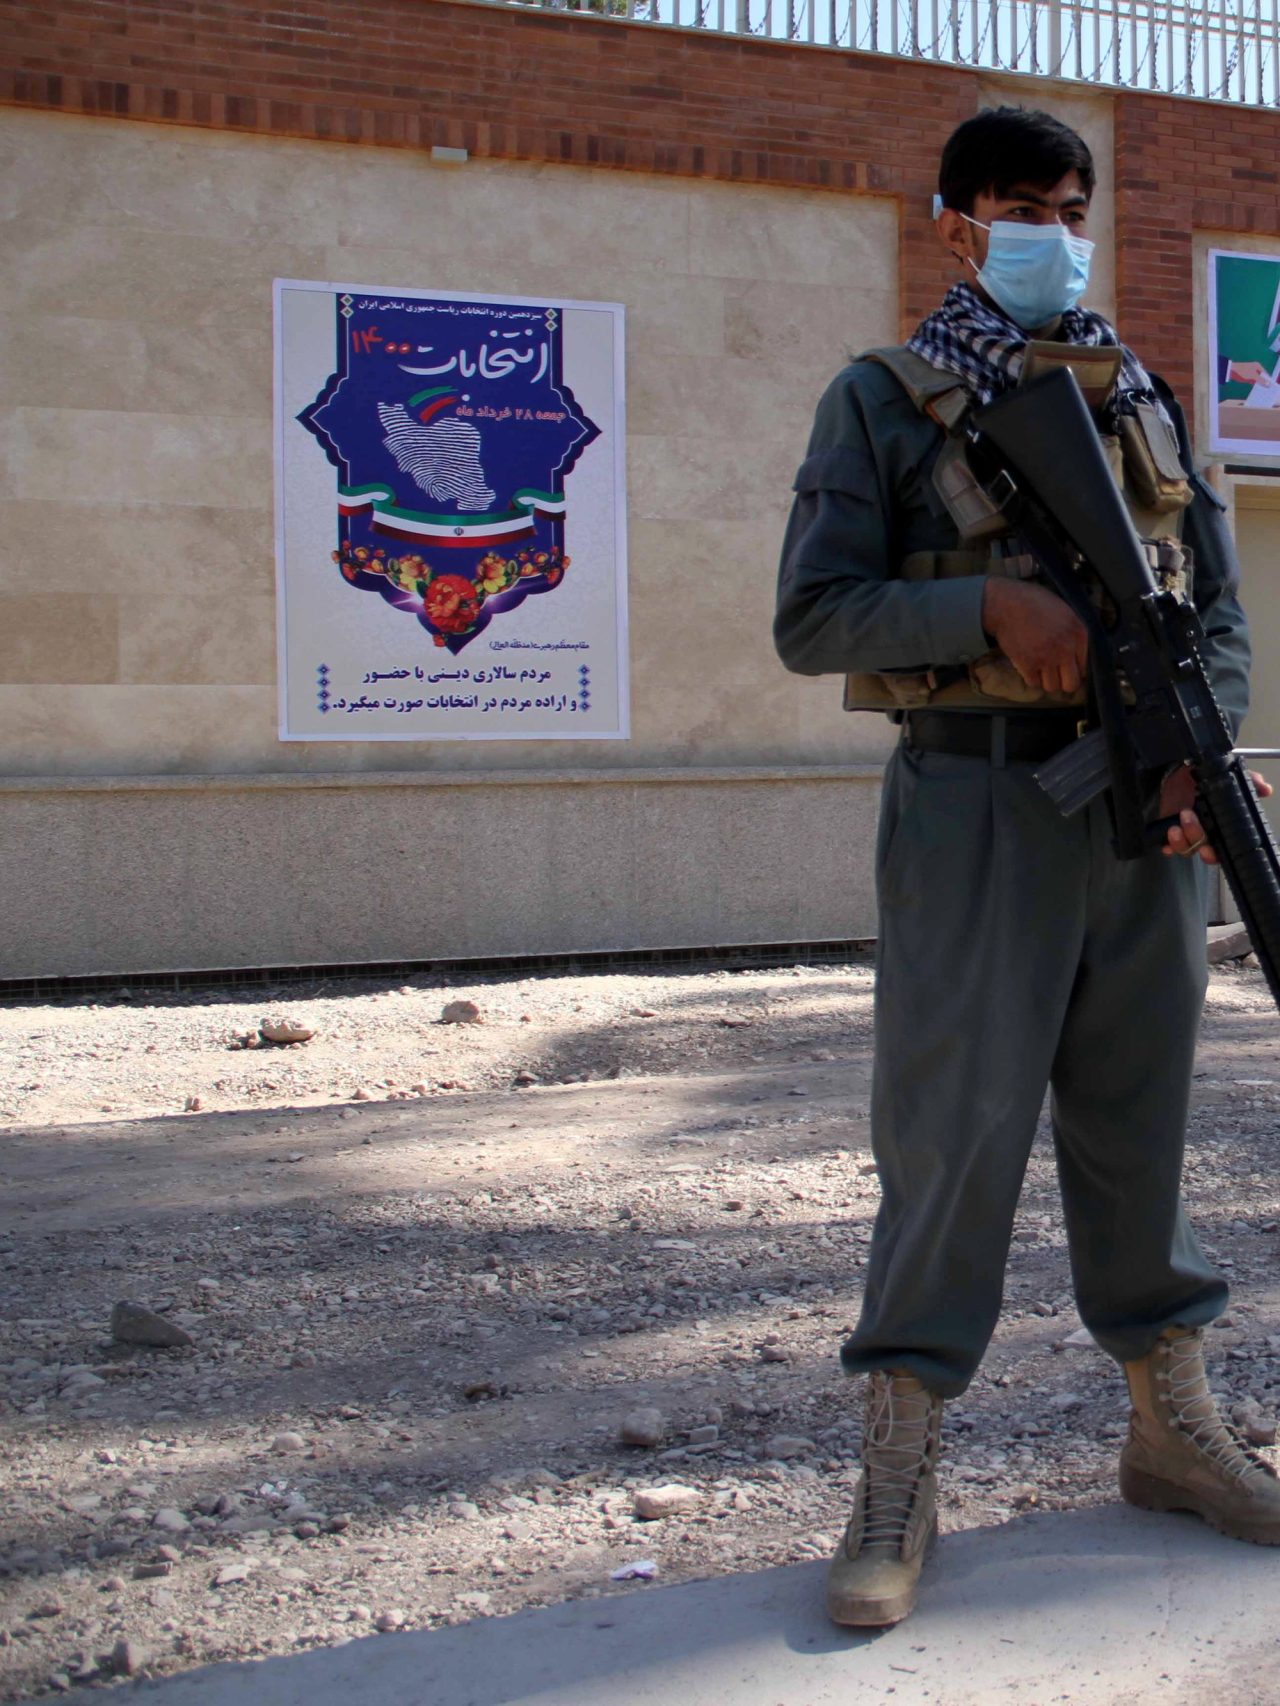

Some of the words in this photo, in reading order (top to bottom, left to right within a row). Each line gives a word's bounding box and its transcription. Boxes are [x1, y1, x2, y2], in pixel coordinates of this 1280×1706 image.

[358, 300, 379, 310] ایران
[379, 302, 405, 311] اسلامی
[405, 304, 435, 314] جمهوری
[436, 304, 460, 316] ریاست
[460, 307, 489, 317] انتخابات
[490, 310, 507, 319] دوره
[508, 311, 542, 321] سیزدهمین
[397, 328, 548, 402] انتخابات
[456, 404, 474, 417] ماه
[476, 405, 513, 422] خرداد
[515, 408, 533, 420] ۲۸
[536, 410, 567, 424] جمعه
[361, 665, 411, 684] حضور
[414, 665, 425, 683] با
[427, 668, 470, 684] دینی
[473, 666, 517, 684] سالاری
[519, 669, 552, 684] مردم
[382, 697, 424, 713] صورت
[426, 694, 479, 712] انتخابات
[481, 697, 498, 713] در
[501, 697, 532, 712] مردم
[534, 694, 567, 712] اراده
[569, 699, 578, 712] و
